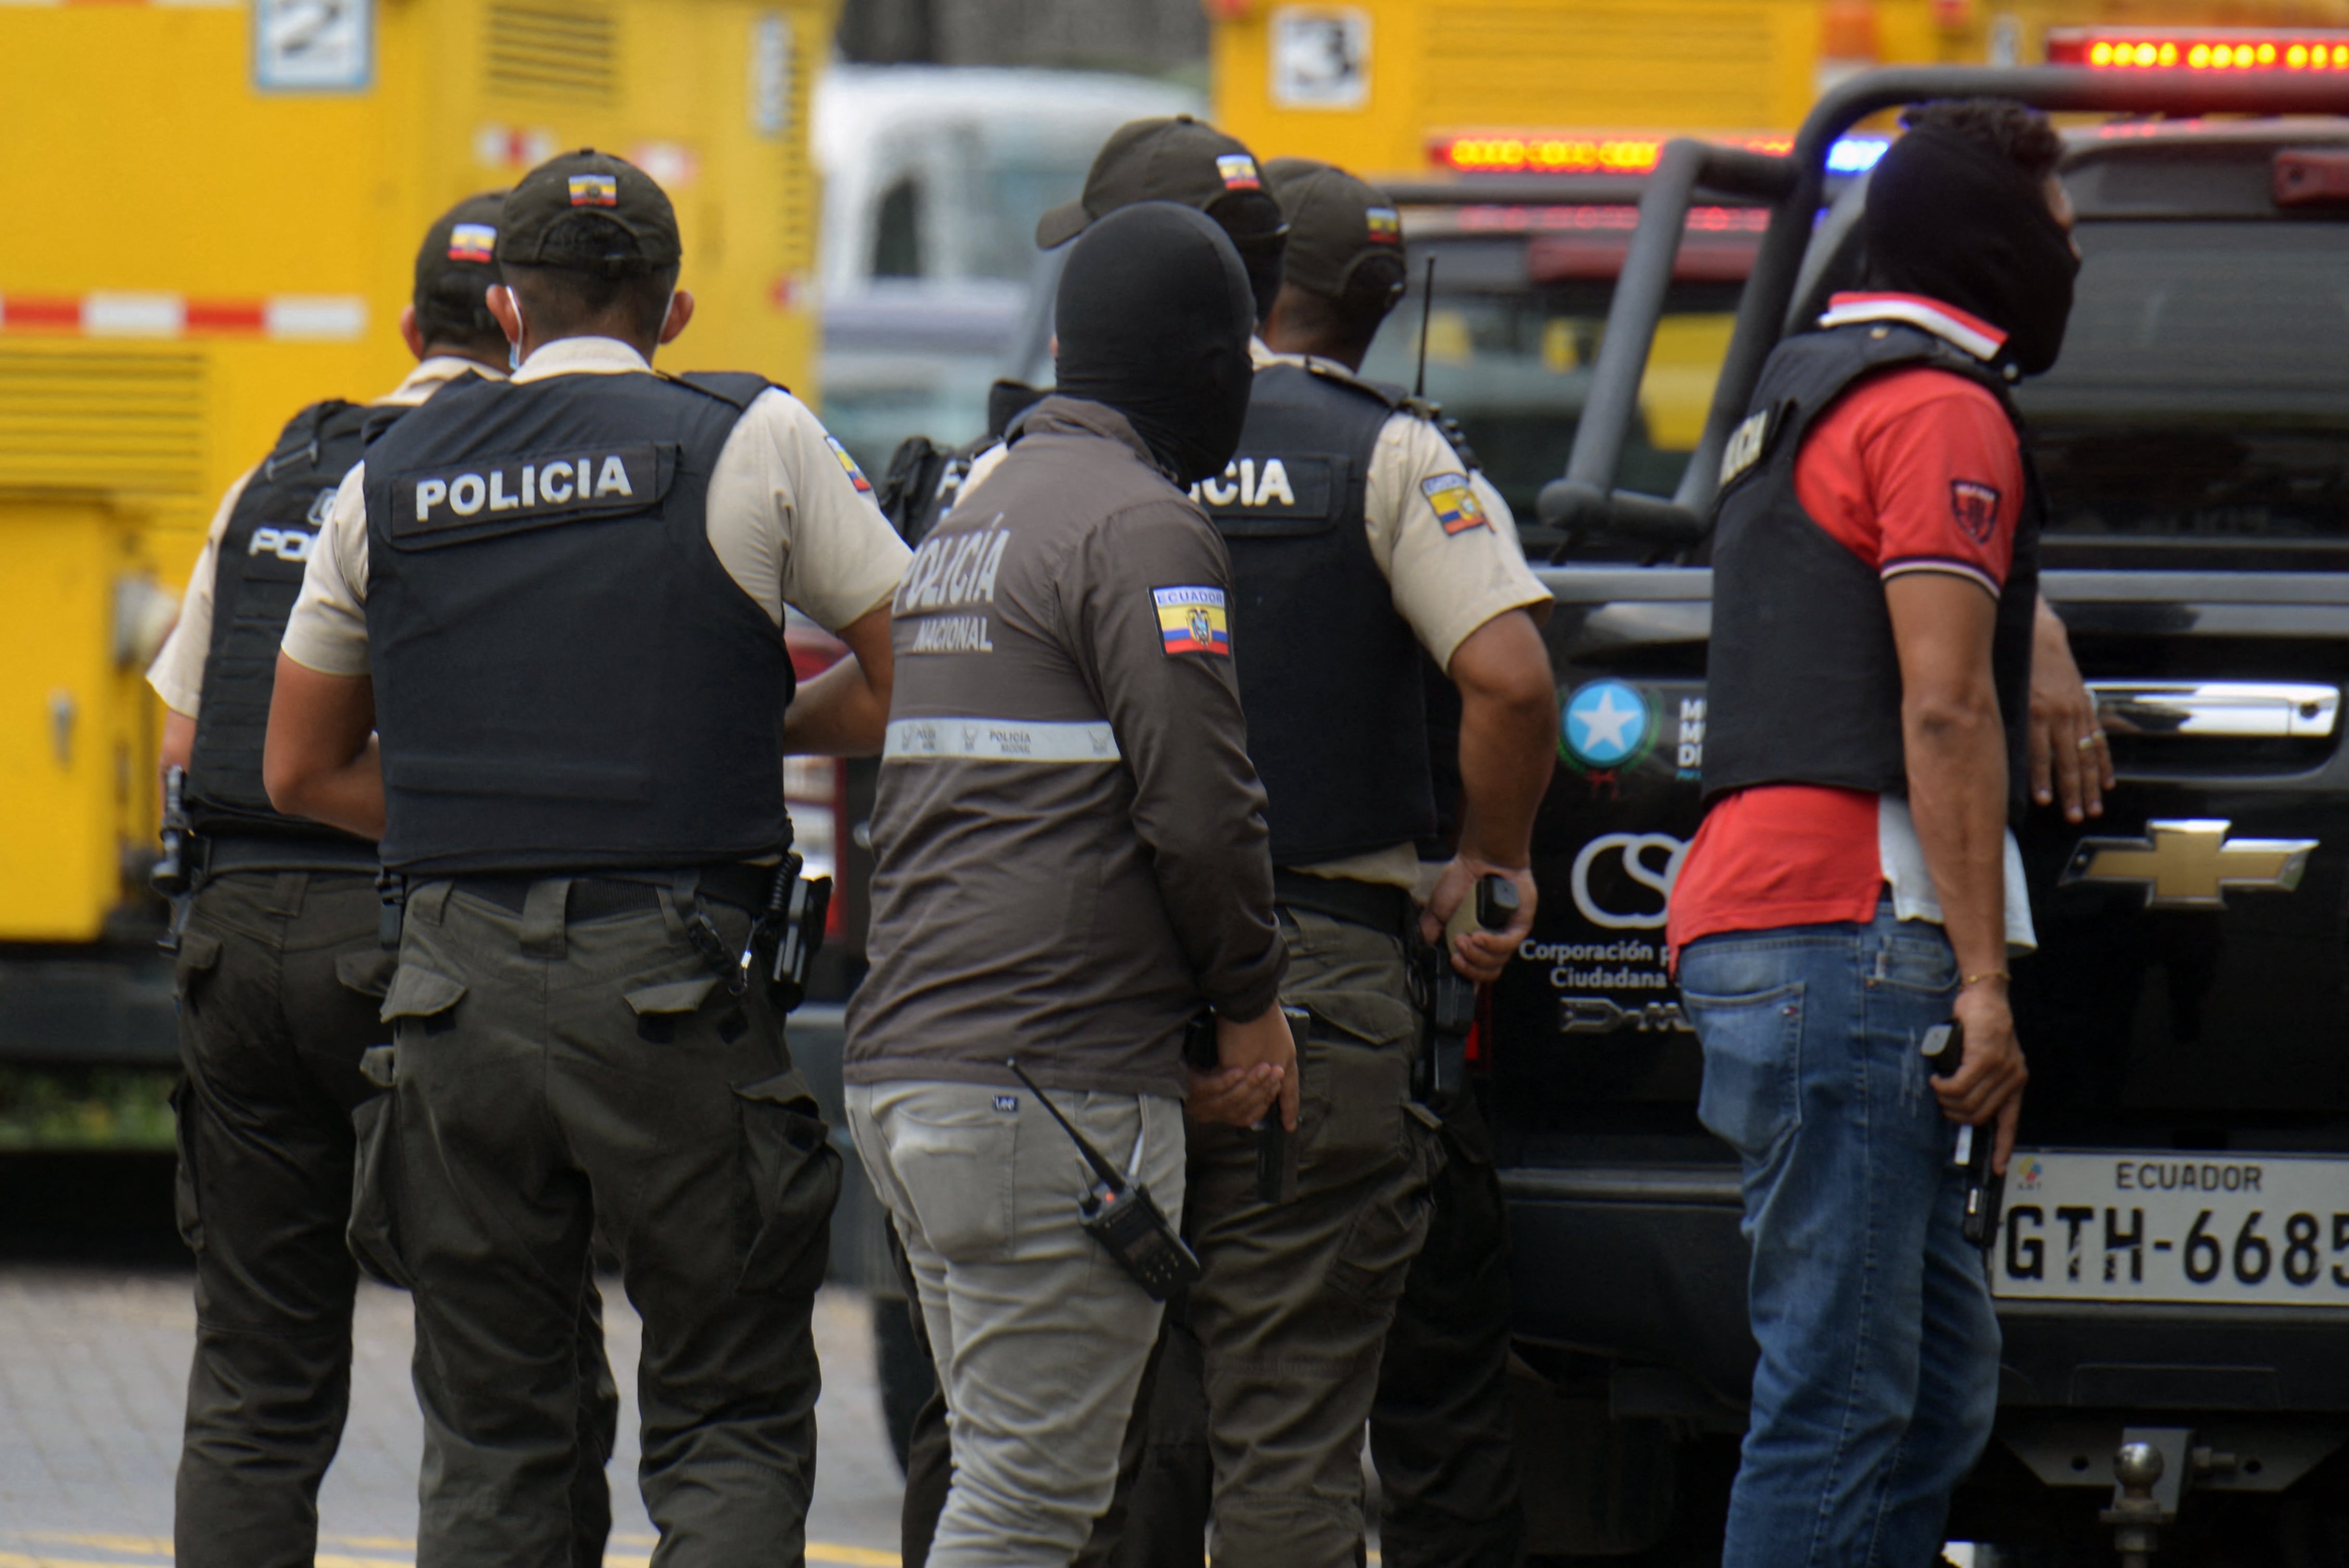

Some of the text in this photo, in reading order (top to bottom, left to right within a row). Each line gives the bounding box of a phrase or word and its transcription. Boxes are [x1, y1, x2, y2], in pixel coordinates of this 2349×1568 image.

[417, 455, 633, 522] POLICIA
[1189, 458, 1295, 506] CIA
[913, 616, 993, 652] NACIONAL
[1571, 832, 1694, 929] CS
[1518, 939, 1654, 966] Corporación
[1550, 960, 1667, 988] Ciudadana
[2116, 1161, 2263, 1192] ECUADOR
